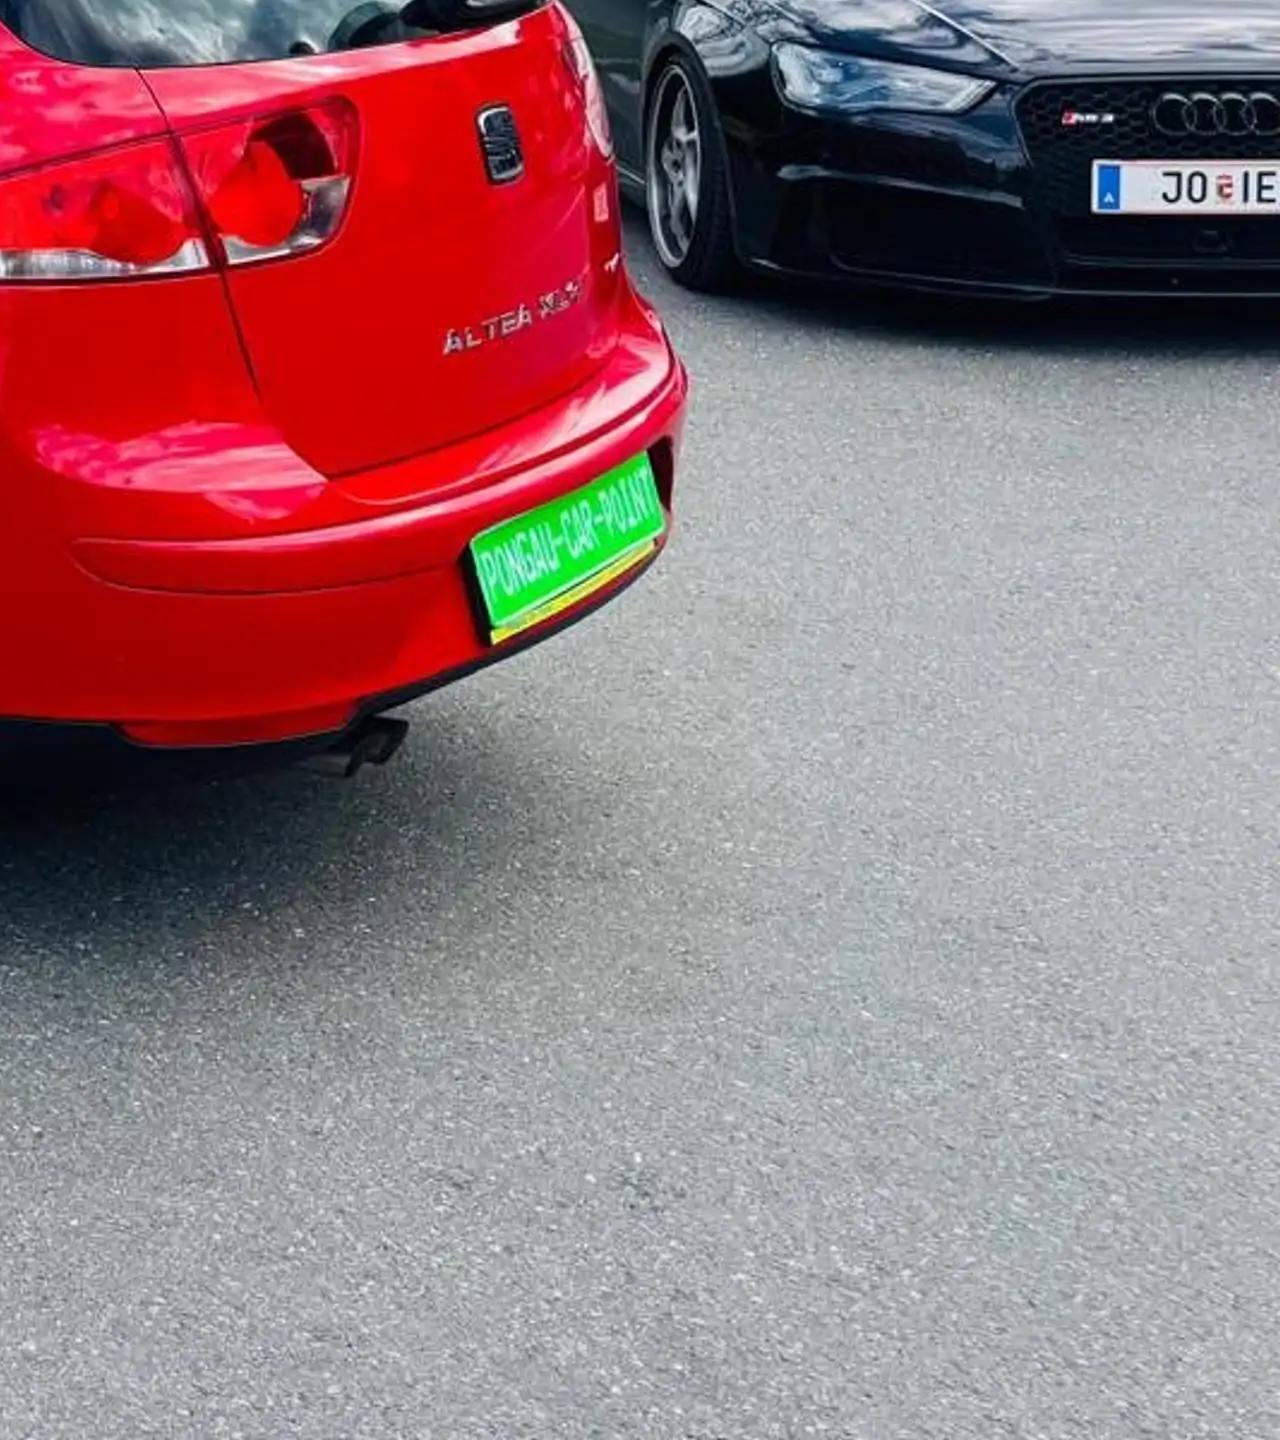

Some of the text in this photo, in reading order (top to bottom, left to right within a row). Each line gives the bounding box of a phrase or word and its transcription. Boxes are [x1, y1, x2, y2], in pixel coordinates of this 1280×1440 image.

[1161, 171, 1208, 204] JO
[443, 303, 534, 356] ALTEA
[479, 466, 657, 603] PONGAU-CAR-POINT
